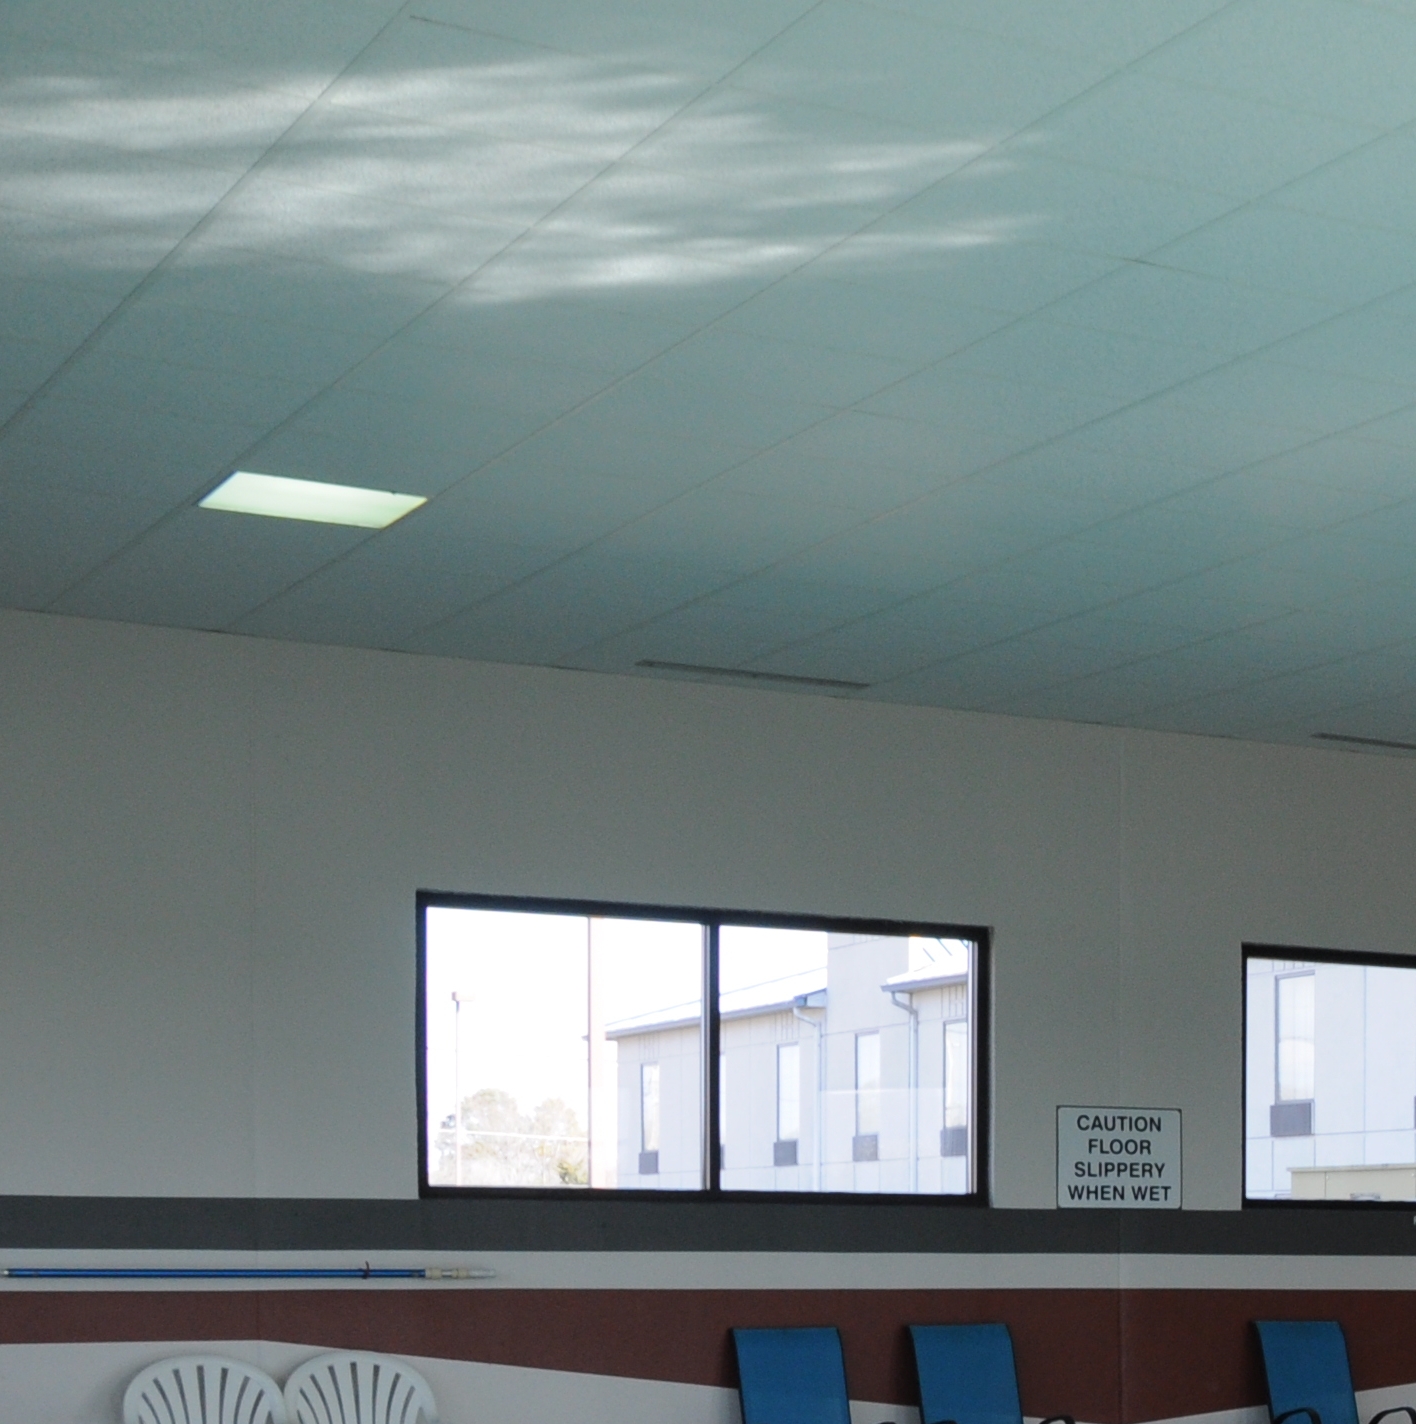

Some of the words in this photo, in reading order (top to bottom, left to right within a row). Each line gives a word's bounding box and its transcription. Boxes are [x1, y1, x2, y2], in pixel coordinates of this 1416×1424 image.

[1077, 1115, 1162, 1132] CAUTION
[1088, 1139, 1152, 1155] FLOOR
[1074, 1161, 1165, 1178] SLIPPERY
[1068, 1185, 1125, 1201] WHEN
[1131, 1185, 1172, 1201] WET
